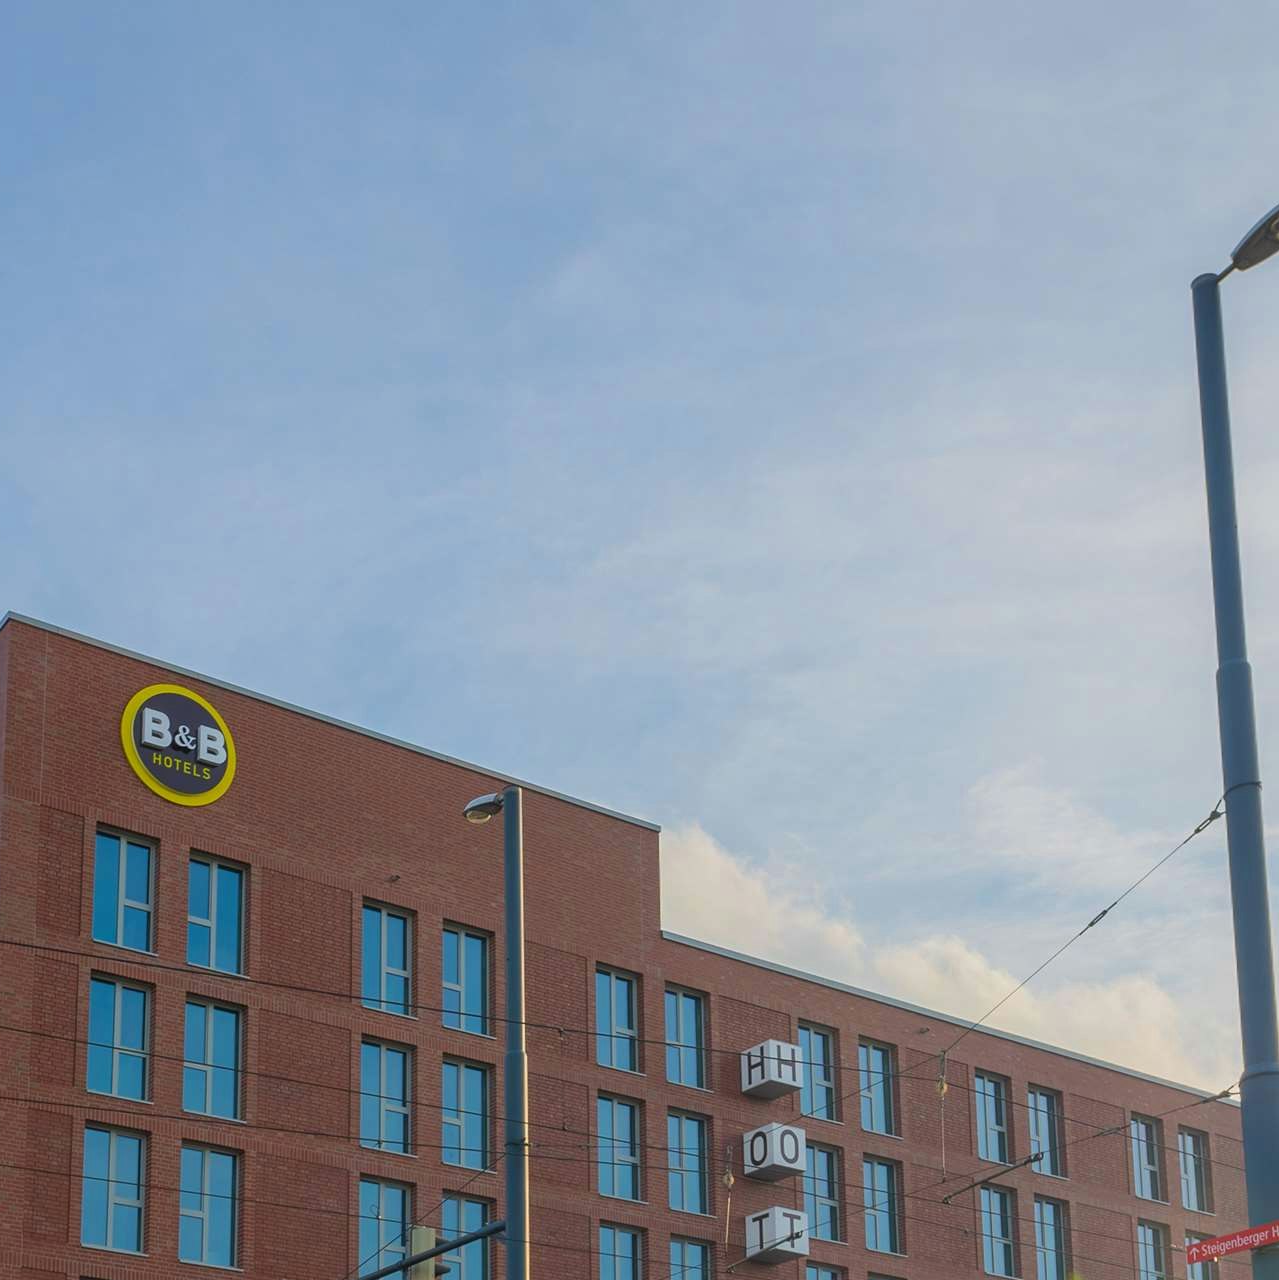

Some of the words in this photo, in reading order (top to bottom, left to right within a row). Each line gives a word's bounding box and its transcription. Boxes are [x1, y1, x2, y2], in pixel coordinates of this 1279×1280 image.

[142, 707, 228, 765] B&B
[153, 752, 211, 780] HOTELS
[1201, 1229, 1270, 1257] Steigenberger
